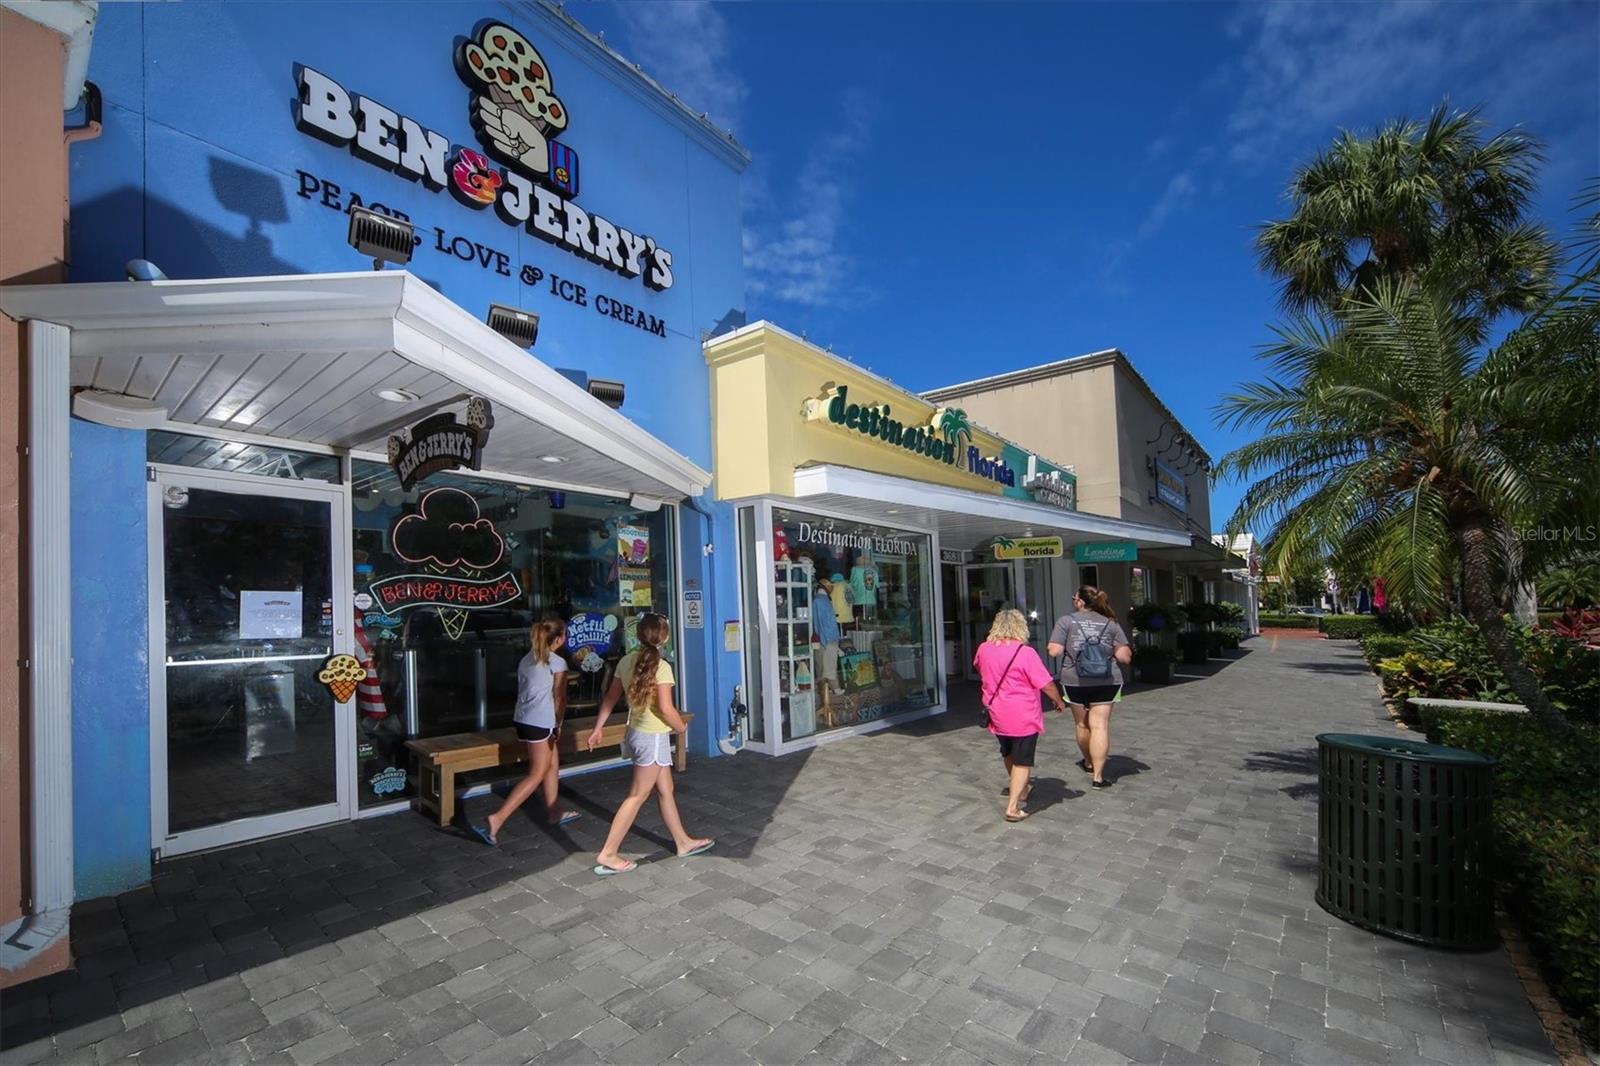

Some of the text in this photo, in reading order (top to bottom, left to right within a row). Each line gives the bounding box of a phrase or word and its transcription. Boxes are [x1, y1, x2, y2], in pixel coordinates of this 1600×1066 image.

[299, 65, 674, 290] BEN & JERRY'S
[433, 226, 511, 277] LOVE
[520, 264, 544, 286] &
[550, 274, 588, 307] ICE
[595, 294, 667, 338] CREAM
[828, 385, 1016, 488] destination florida
[399, 443, 419, 482] BEN
[427, 431, 473, 461] JERRY'S
[798, 522, 918, 556] Destination FLORIDA
[1018, 540, 1059, 557] destination florida
[1084, 546, 1126, 558] Landing
[380, 582, 421, 604] BEN
[423, 582, 442, 600] &
[444, 581, 517, 603] JERRY'S
[568, 619, 608, 637] Netfli
